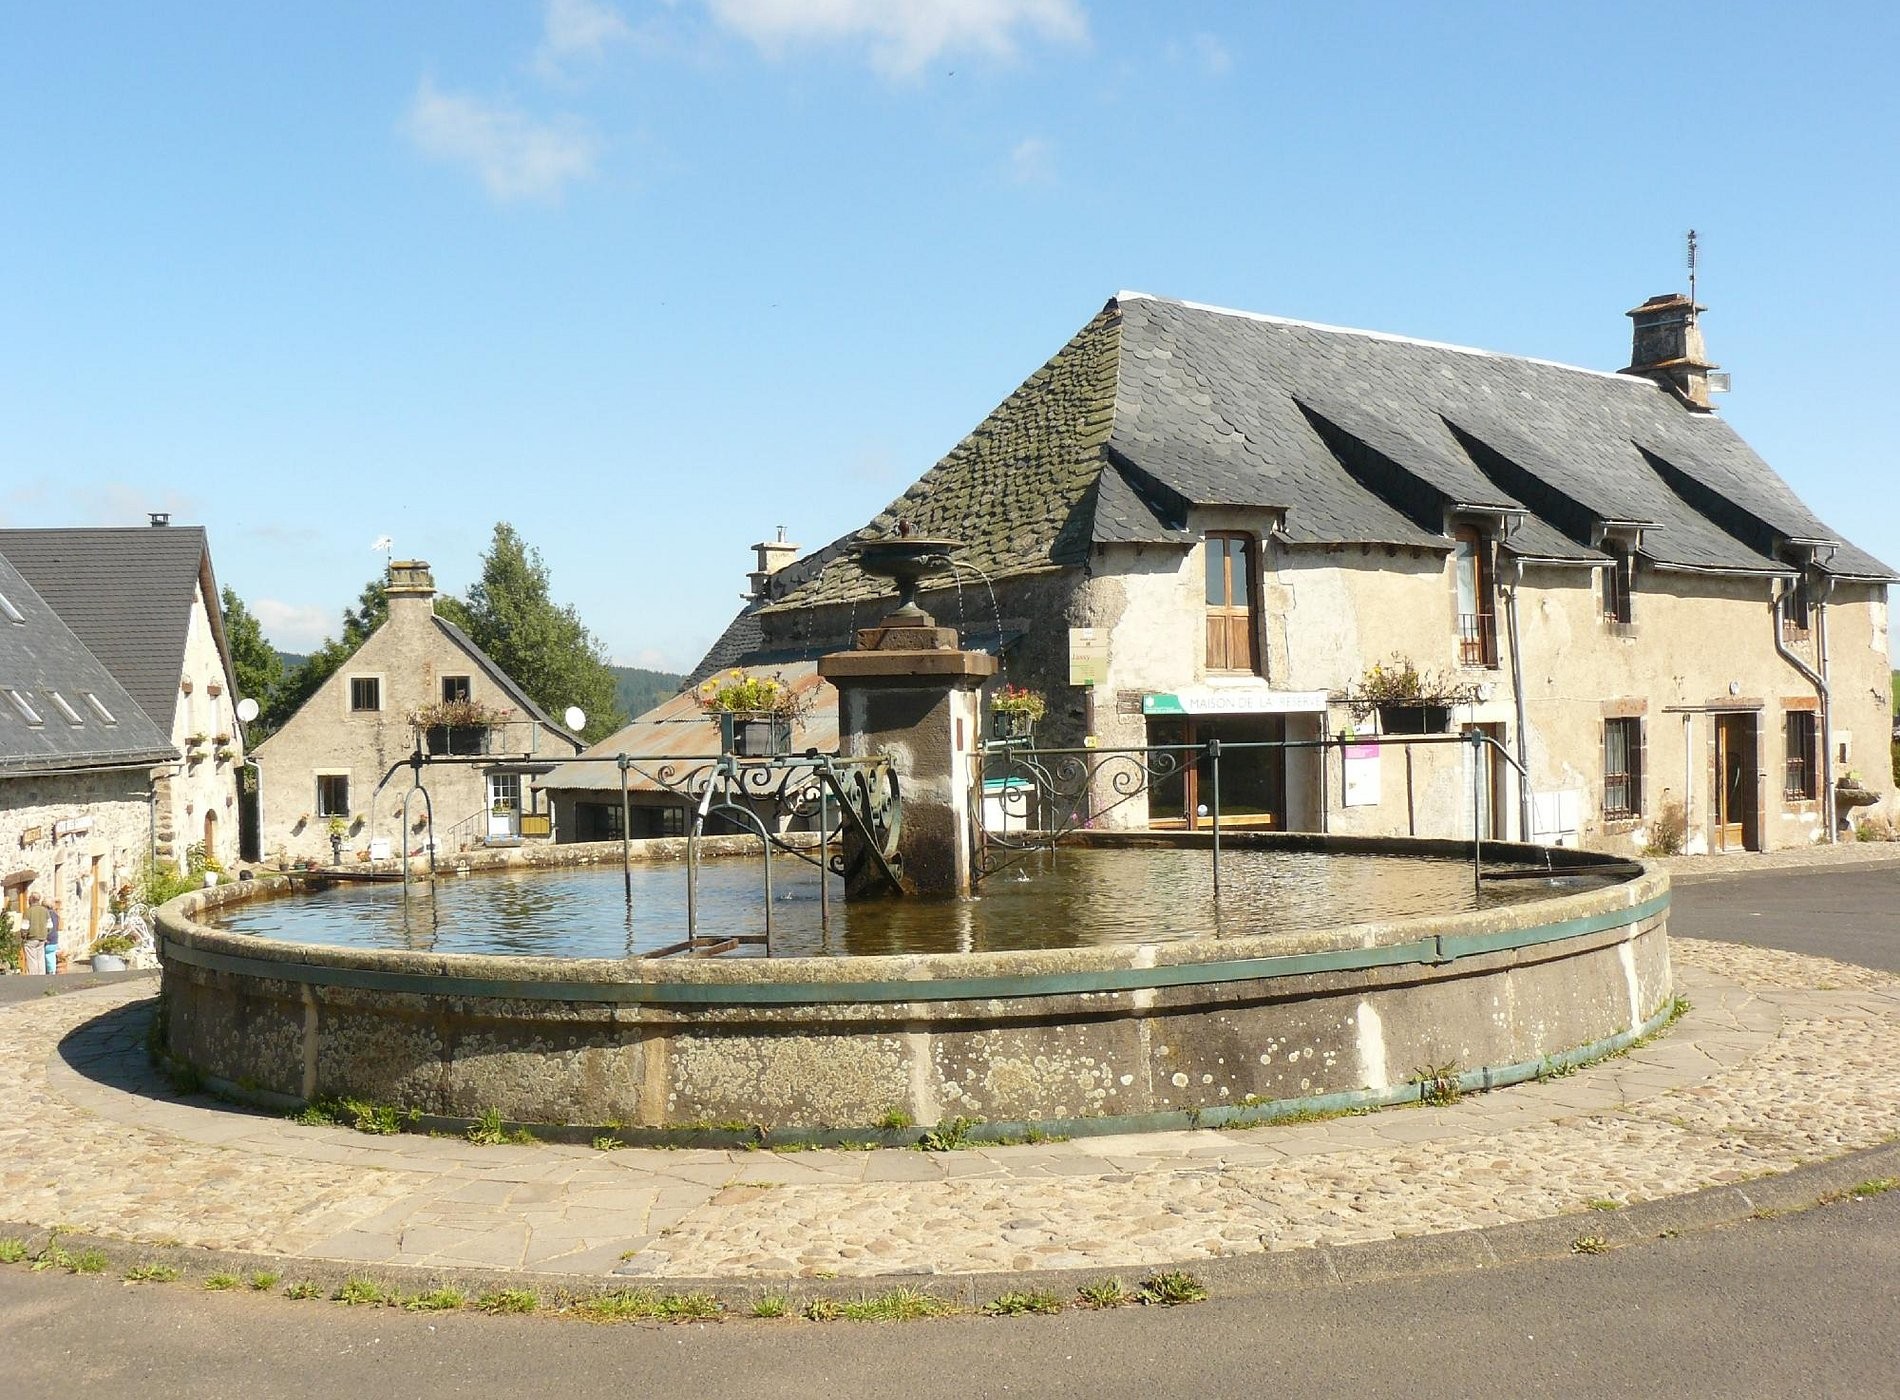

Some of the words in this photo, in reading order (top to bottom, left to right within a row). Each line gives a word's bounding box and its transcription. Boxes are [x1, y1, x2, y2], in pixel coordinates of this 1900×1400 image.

[1190, 697, 1235, 709] MAISON
[1238, 697, 1253, 708] DE
[1259, 696, 1273, 708] LA
